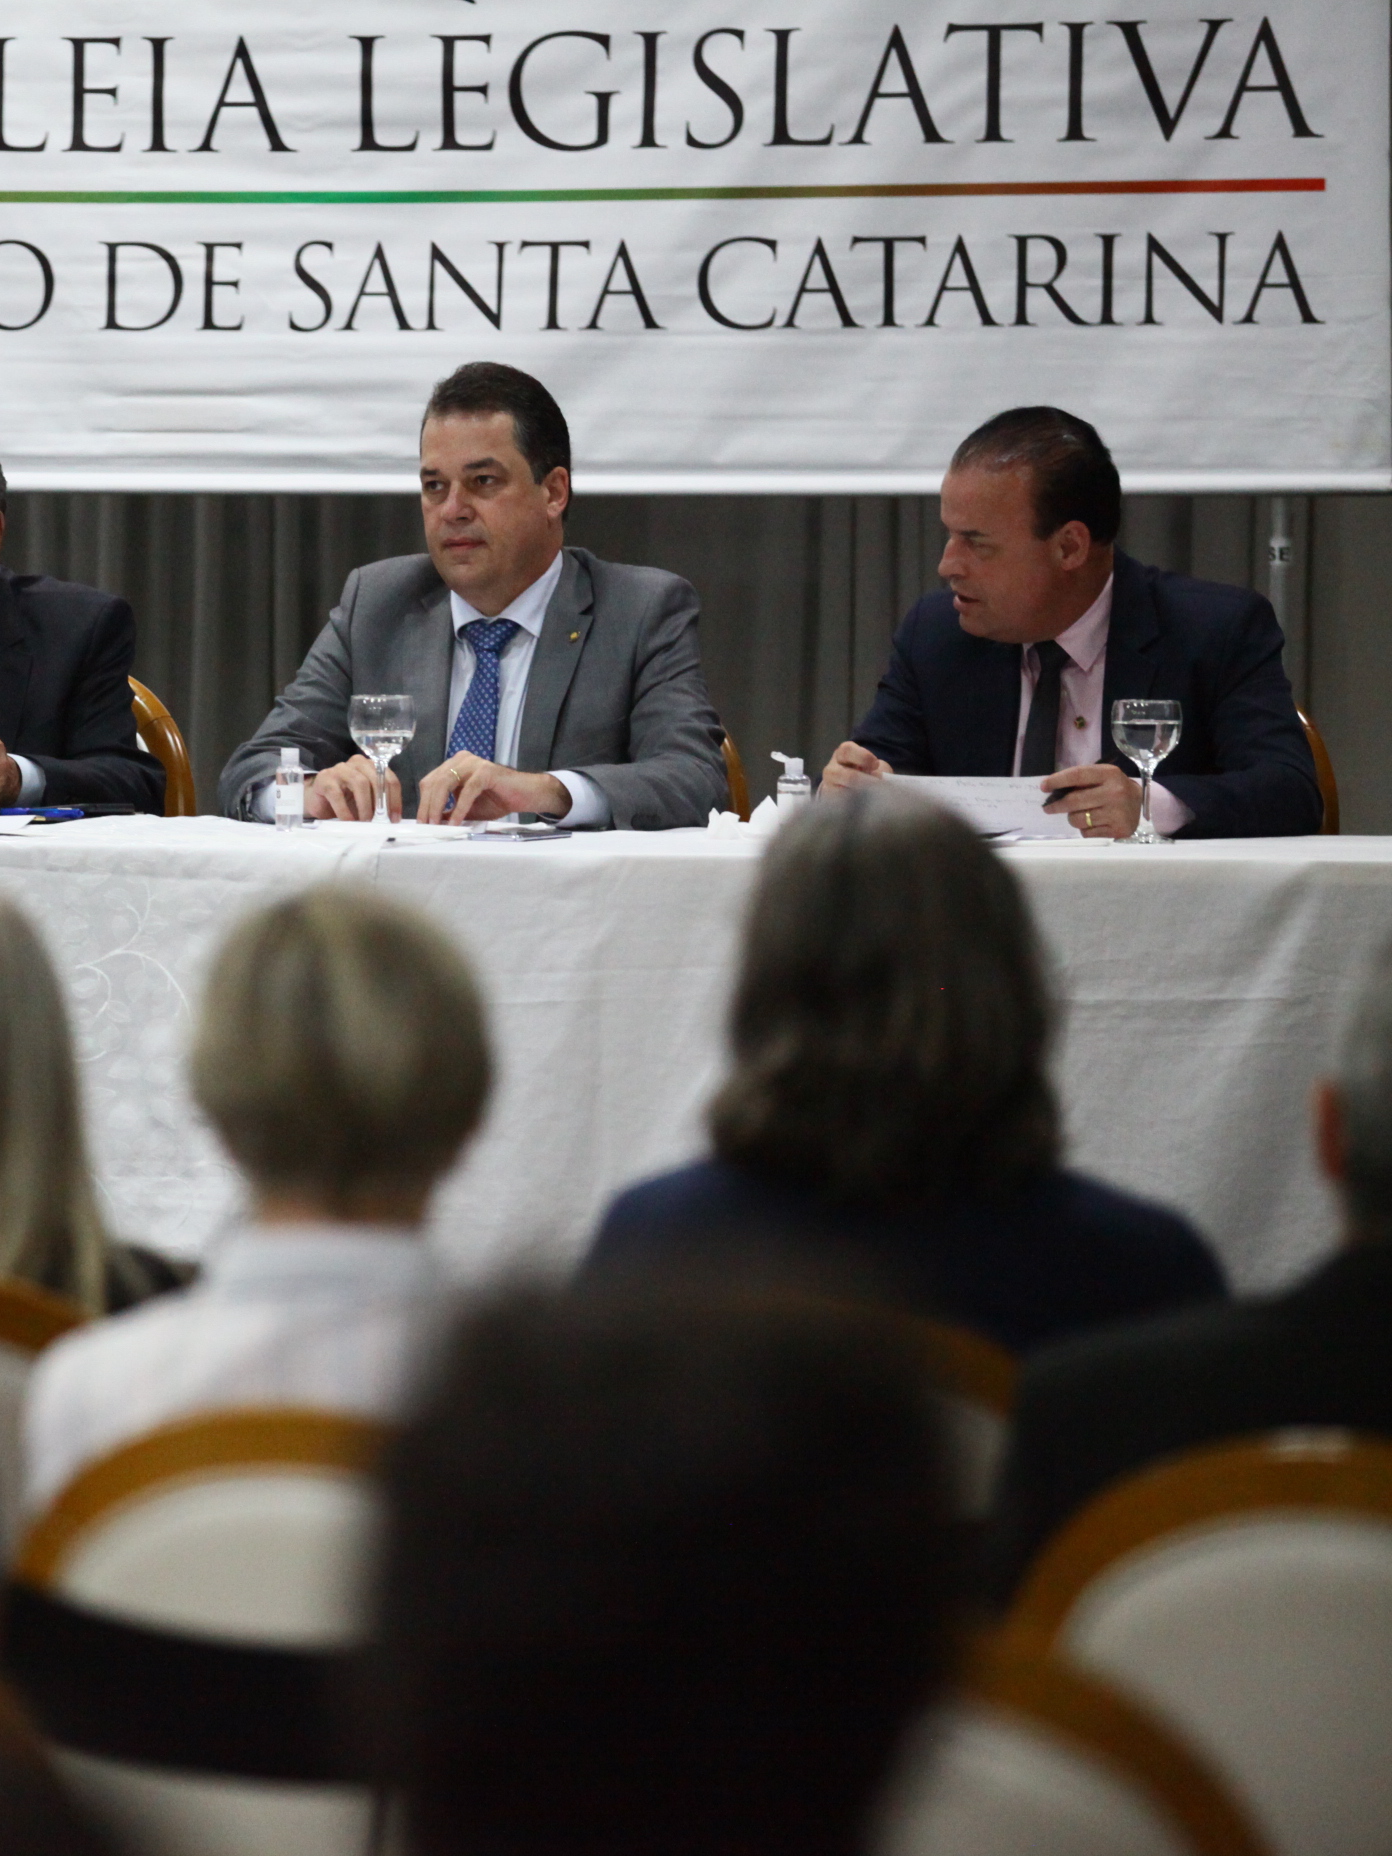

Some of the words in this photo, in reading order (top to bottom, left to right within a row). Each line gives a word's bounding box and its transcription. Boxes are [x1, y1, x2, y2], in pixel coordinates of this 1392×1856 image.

[350, 15, 1326, 152] LEGISLATIVA
[103, 241, 243, 332] DE
[289, 240, 663, 333] SANTA
[697, 229, 1326, 331] CATARINA
